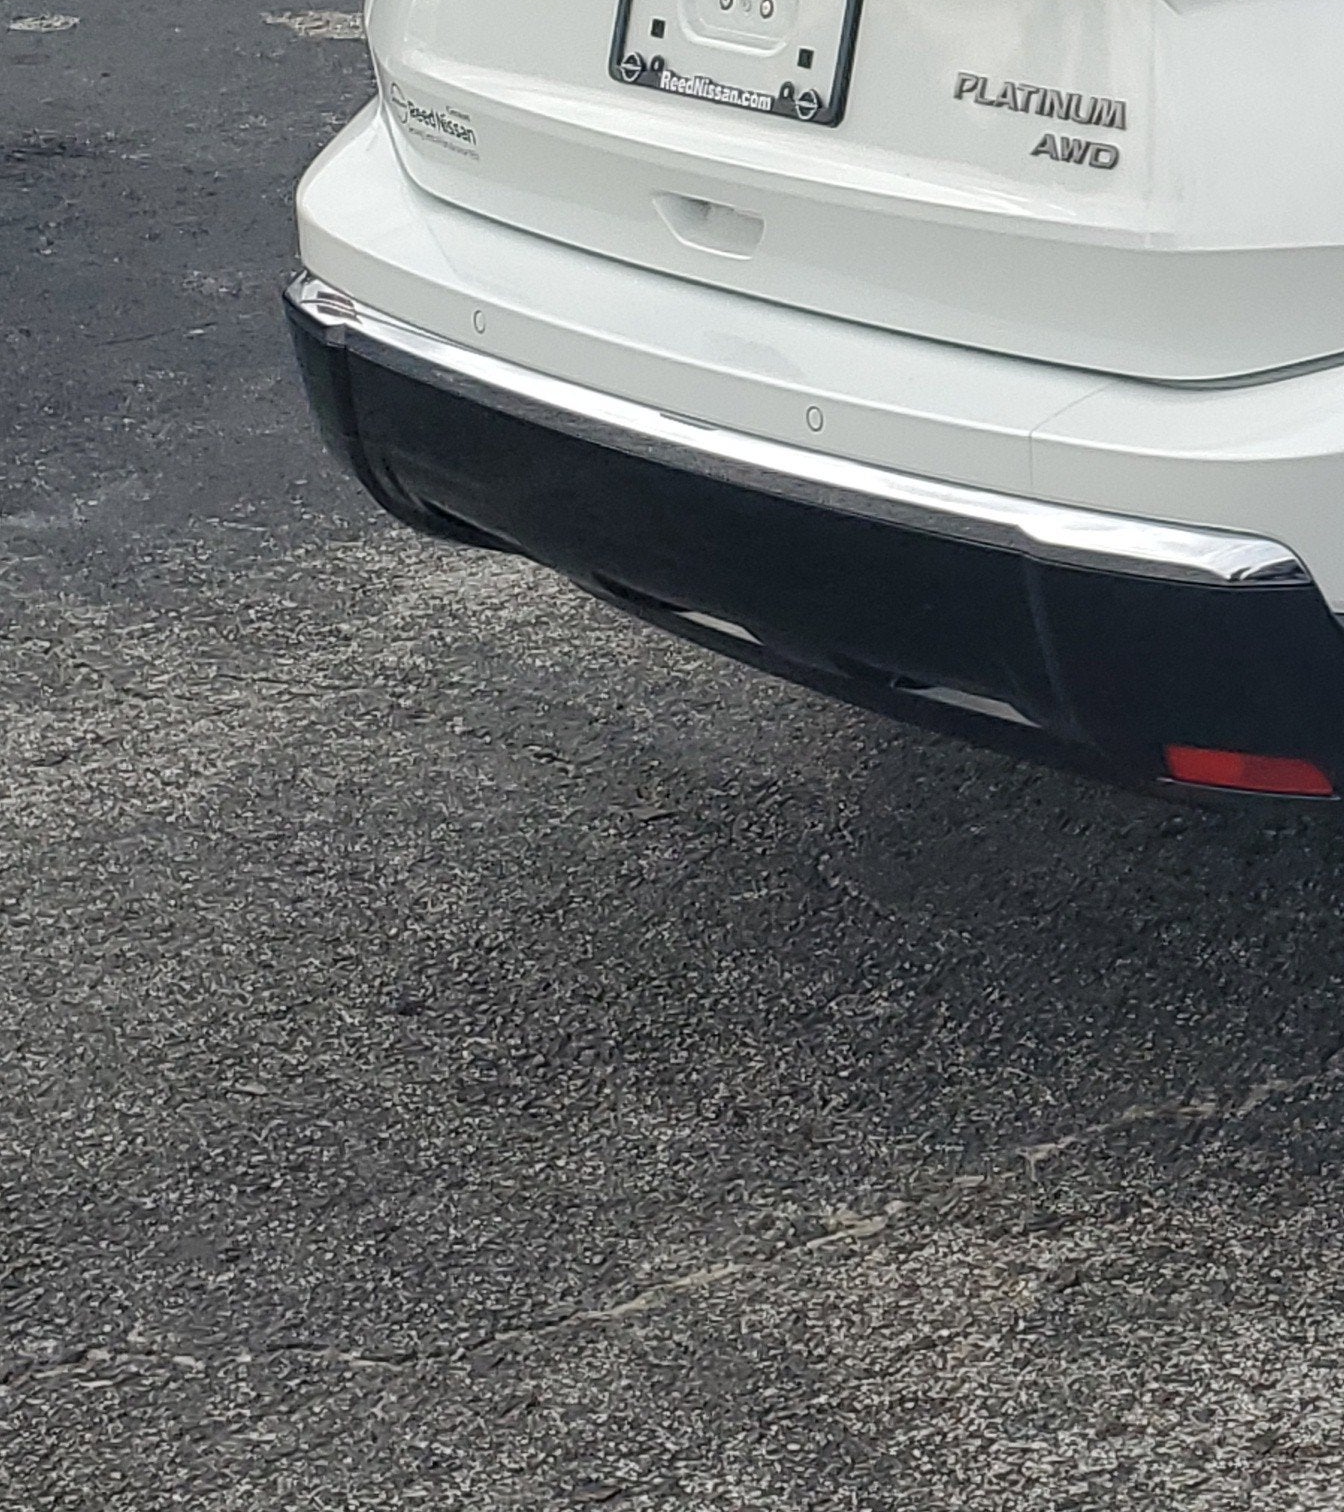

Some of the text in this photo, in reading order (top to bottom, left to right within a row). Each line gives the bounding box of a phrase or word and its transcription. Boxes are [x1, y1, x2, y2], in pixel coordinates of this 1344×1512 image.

[660, 70, 772, 112] ReedNissan.com
[953, 71, 1127, 131] PLATINUM
[1029, 133, 1120, 171] AWD
